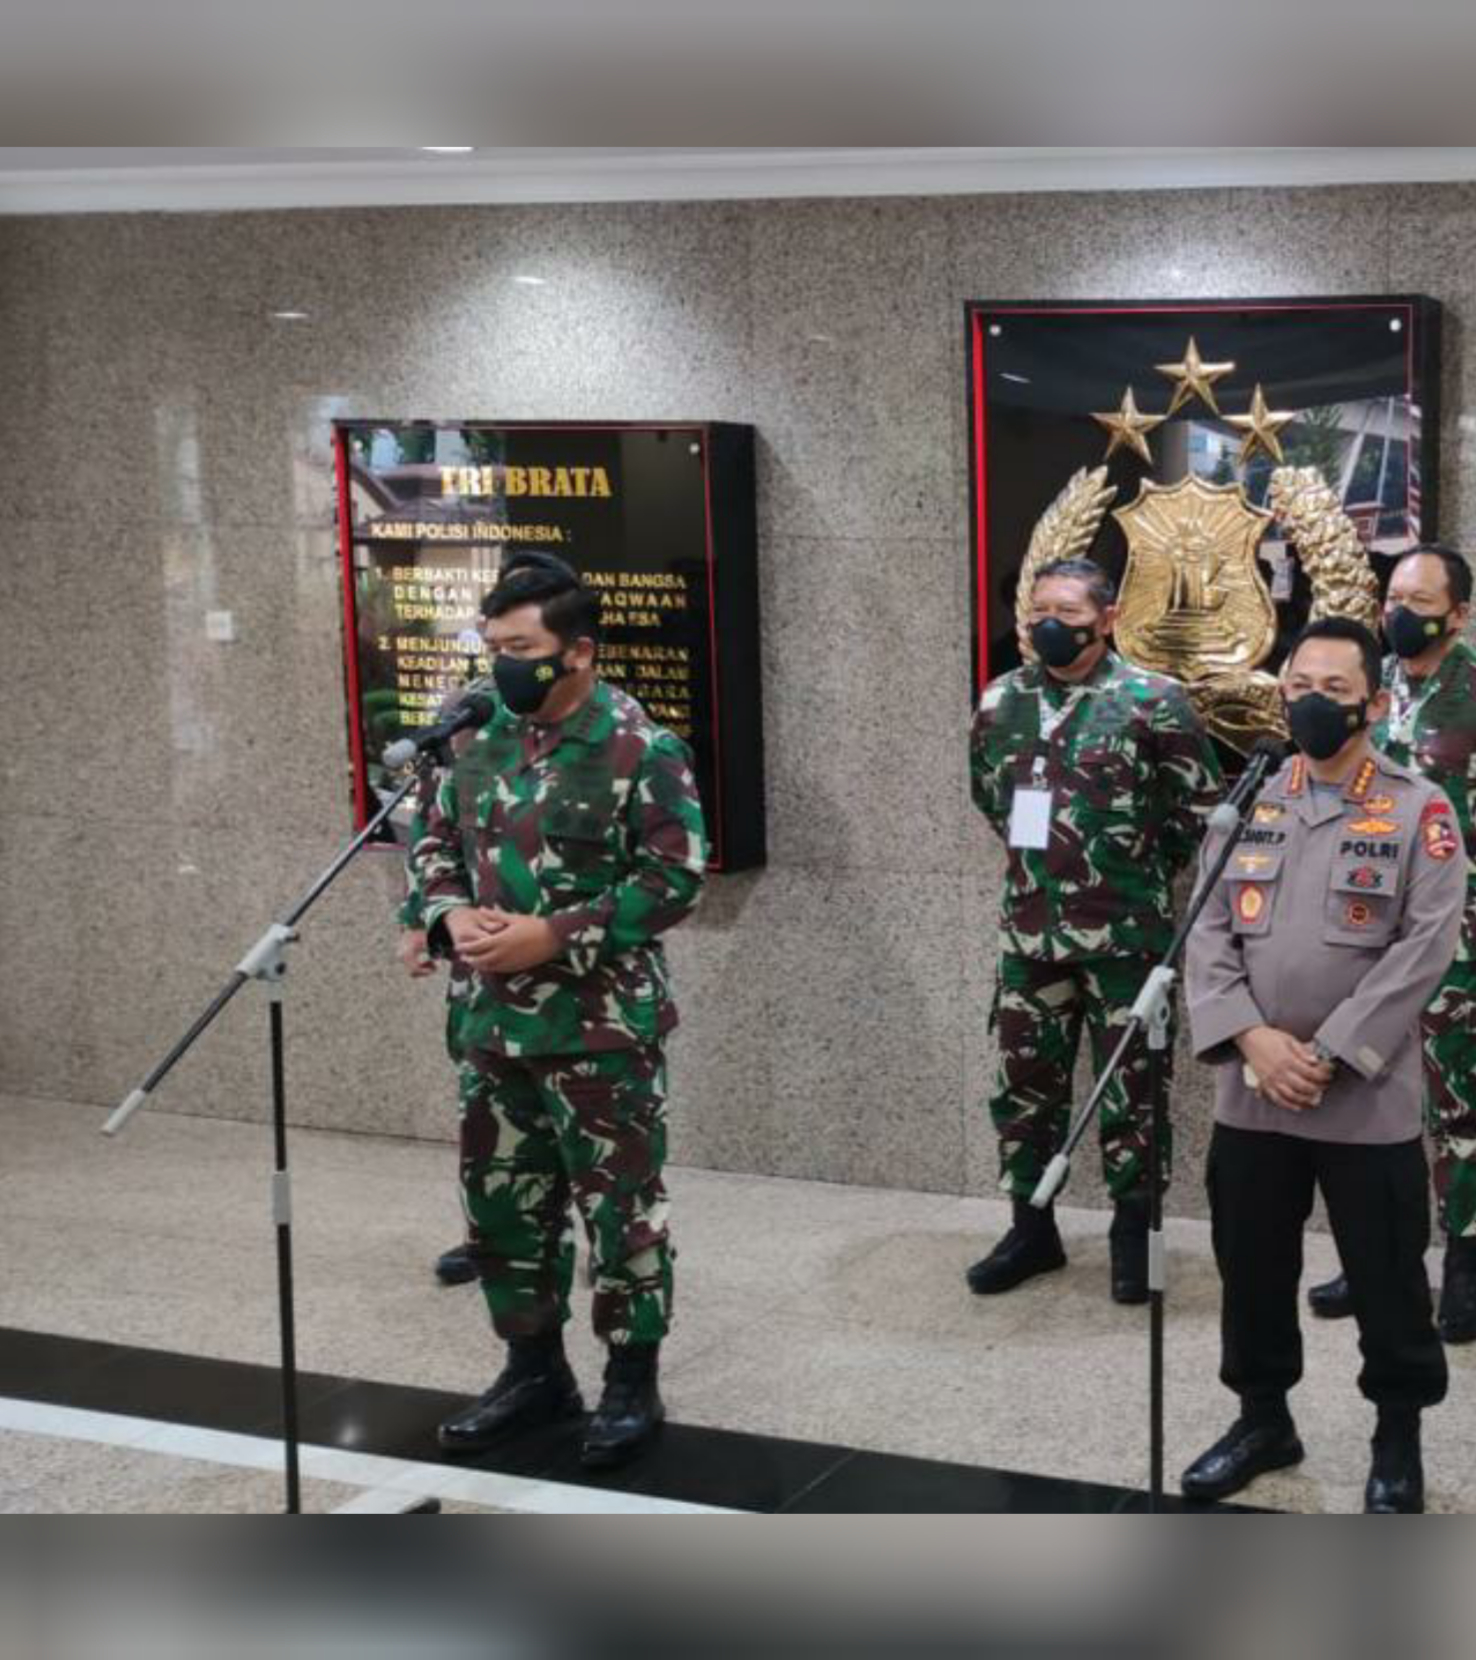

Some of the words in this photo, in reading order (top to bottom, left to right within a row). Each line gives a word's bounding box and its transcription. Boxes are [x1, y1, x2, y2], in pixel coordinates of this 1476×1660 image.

[439, 466, 494, 496] TRI
[504, 466, 612, 498] BRATA
[371, 522, 413, 540] KAMI
[415, 523, 469, 541] POLISI
[473, 523, 563, 543] INDONESIA
[391, 567, 468, 584] BERBAKTI
[618, 572, 686, 589] BANGSA
[394, 588, 472, 602] DENGAN
[600, 591, 686, 608] AQWAAN
[395, 604, 475, 620] TERHADAP
[628, 610, 661, 627] ESA
[598, 645, 689, 661] EBENARAN
[397, 656, 470, 672] KEADILAN
[1340, 840, 1399, 859] POLRI
